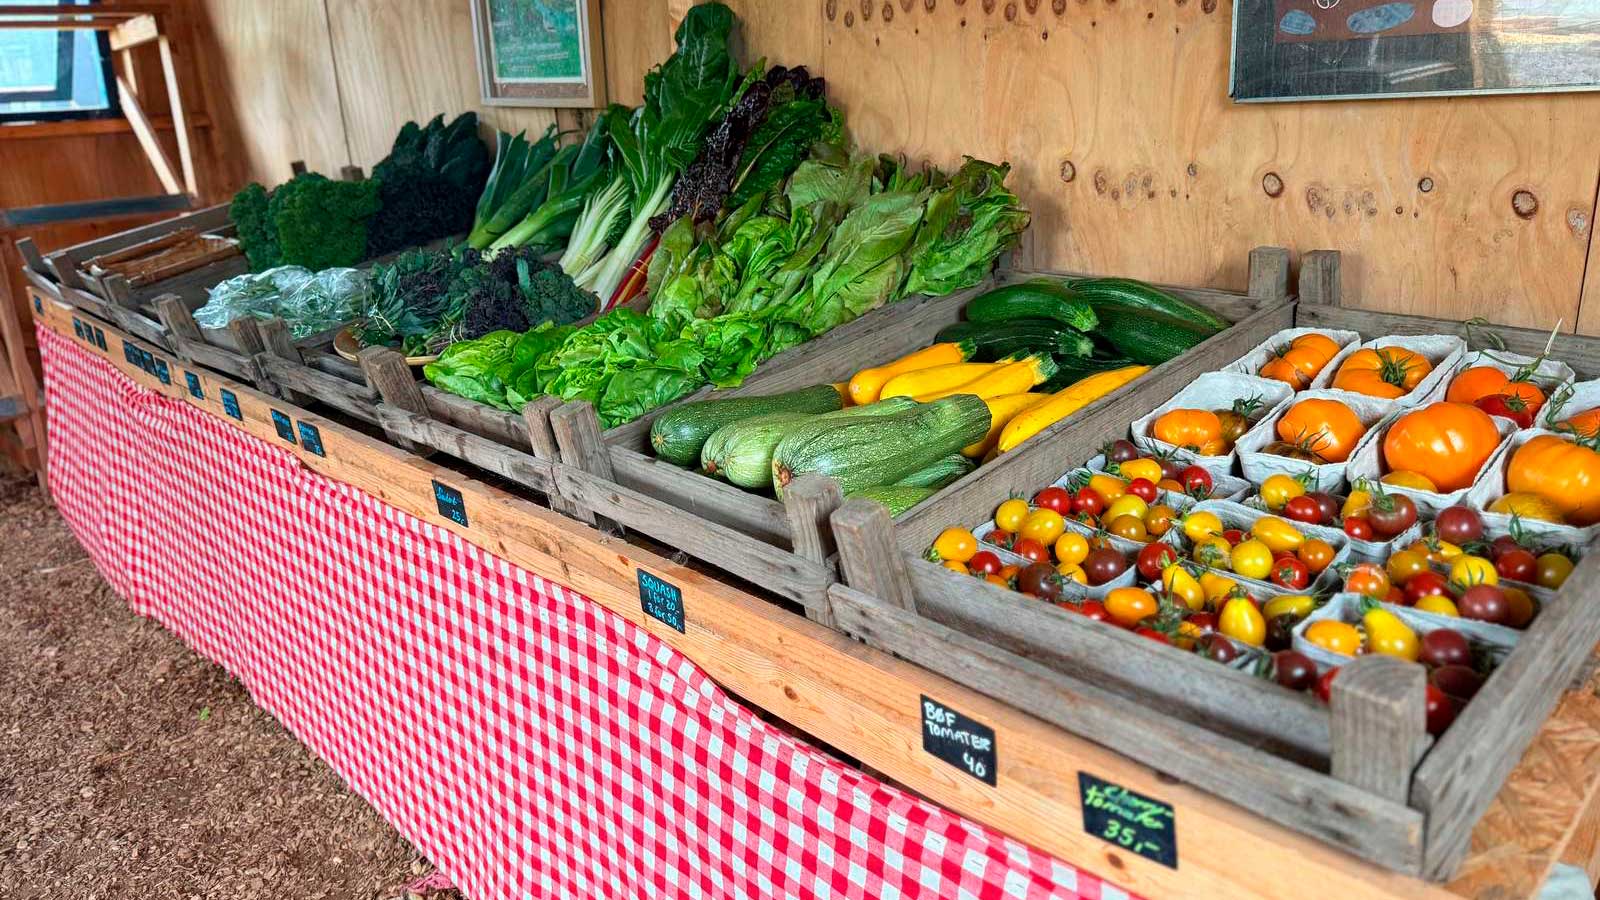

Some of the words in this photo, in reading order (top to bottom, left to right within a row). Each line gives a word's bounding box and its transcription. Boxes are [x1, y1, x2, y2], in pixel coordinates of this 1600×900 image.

[642, 574, 677, 601] SQUASH
[924, 701, 956, 728] BØF
[925, 719, 991, 752] TOMATER
[962, 752, 986, 778] 40
[1103, 819, 1161, 852] 35,-
